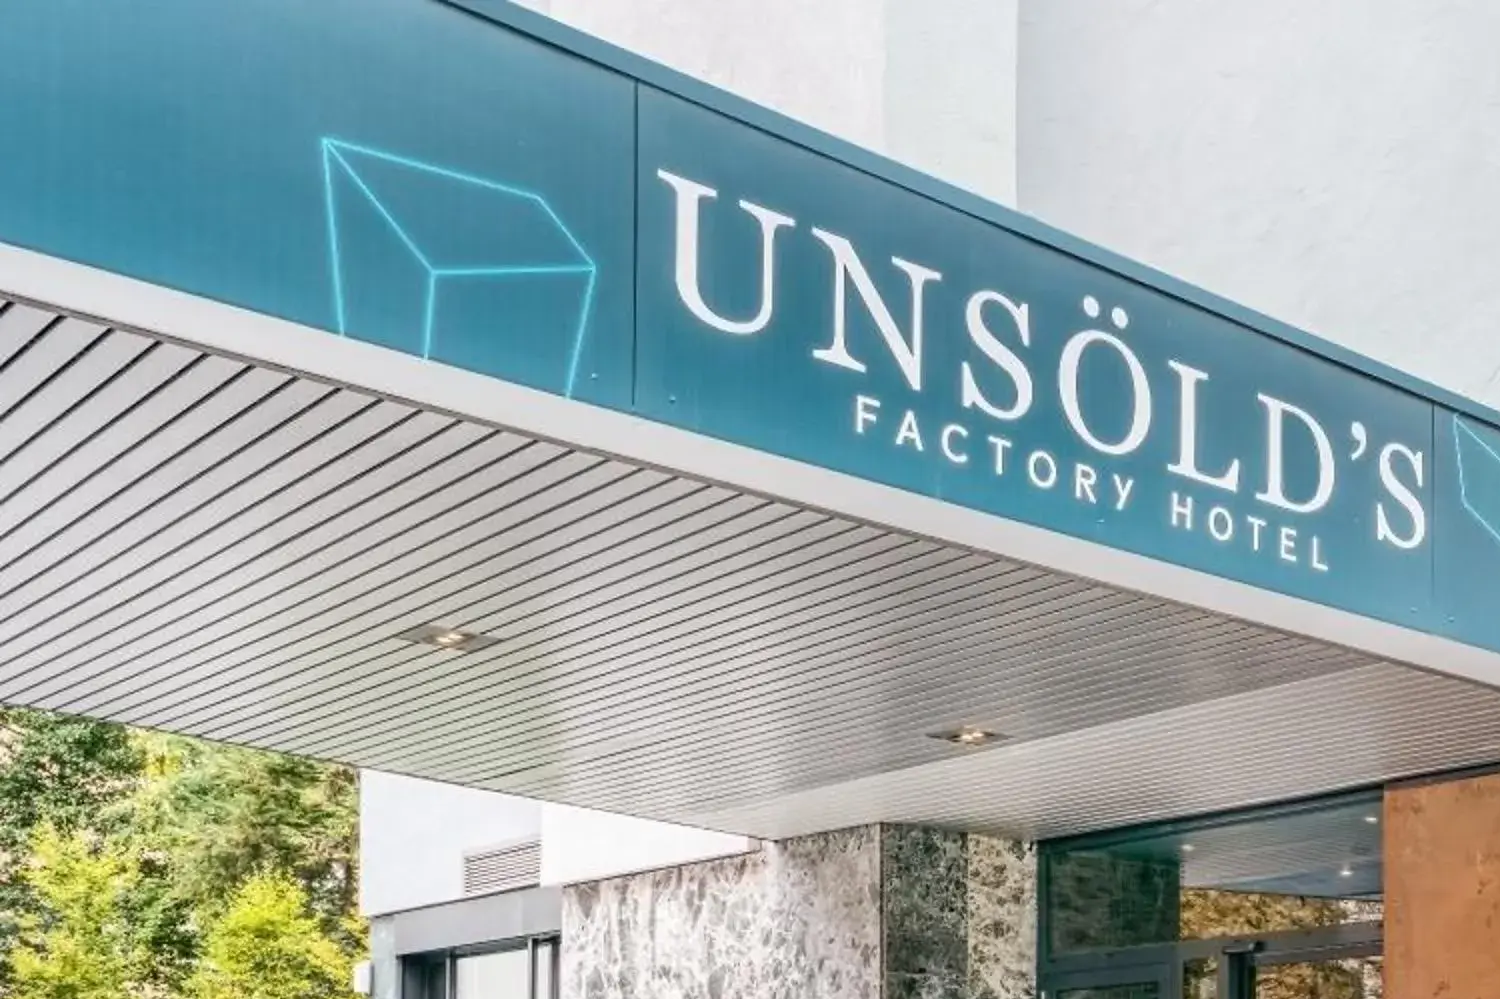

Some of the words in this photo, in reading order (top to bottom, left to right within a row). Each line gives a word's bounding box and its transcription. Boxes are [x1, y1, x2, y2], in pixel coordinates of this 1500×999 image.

[656, 168, 1426, 549] UNSÖLD'S
[853, 394, 1134, 511] FACTORY
[1171, 492, 1329, 572] HOTEL
